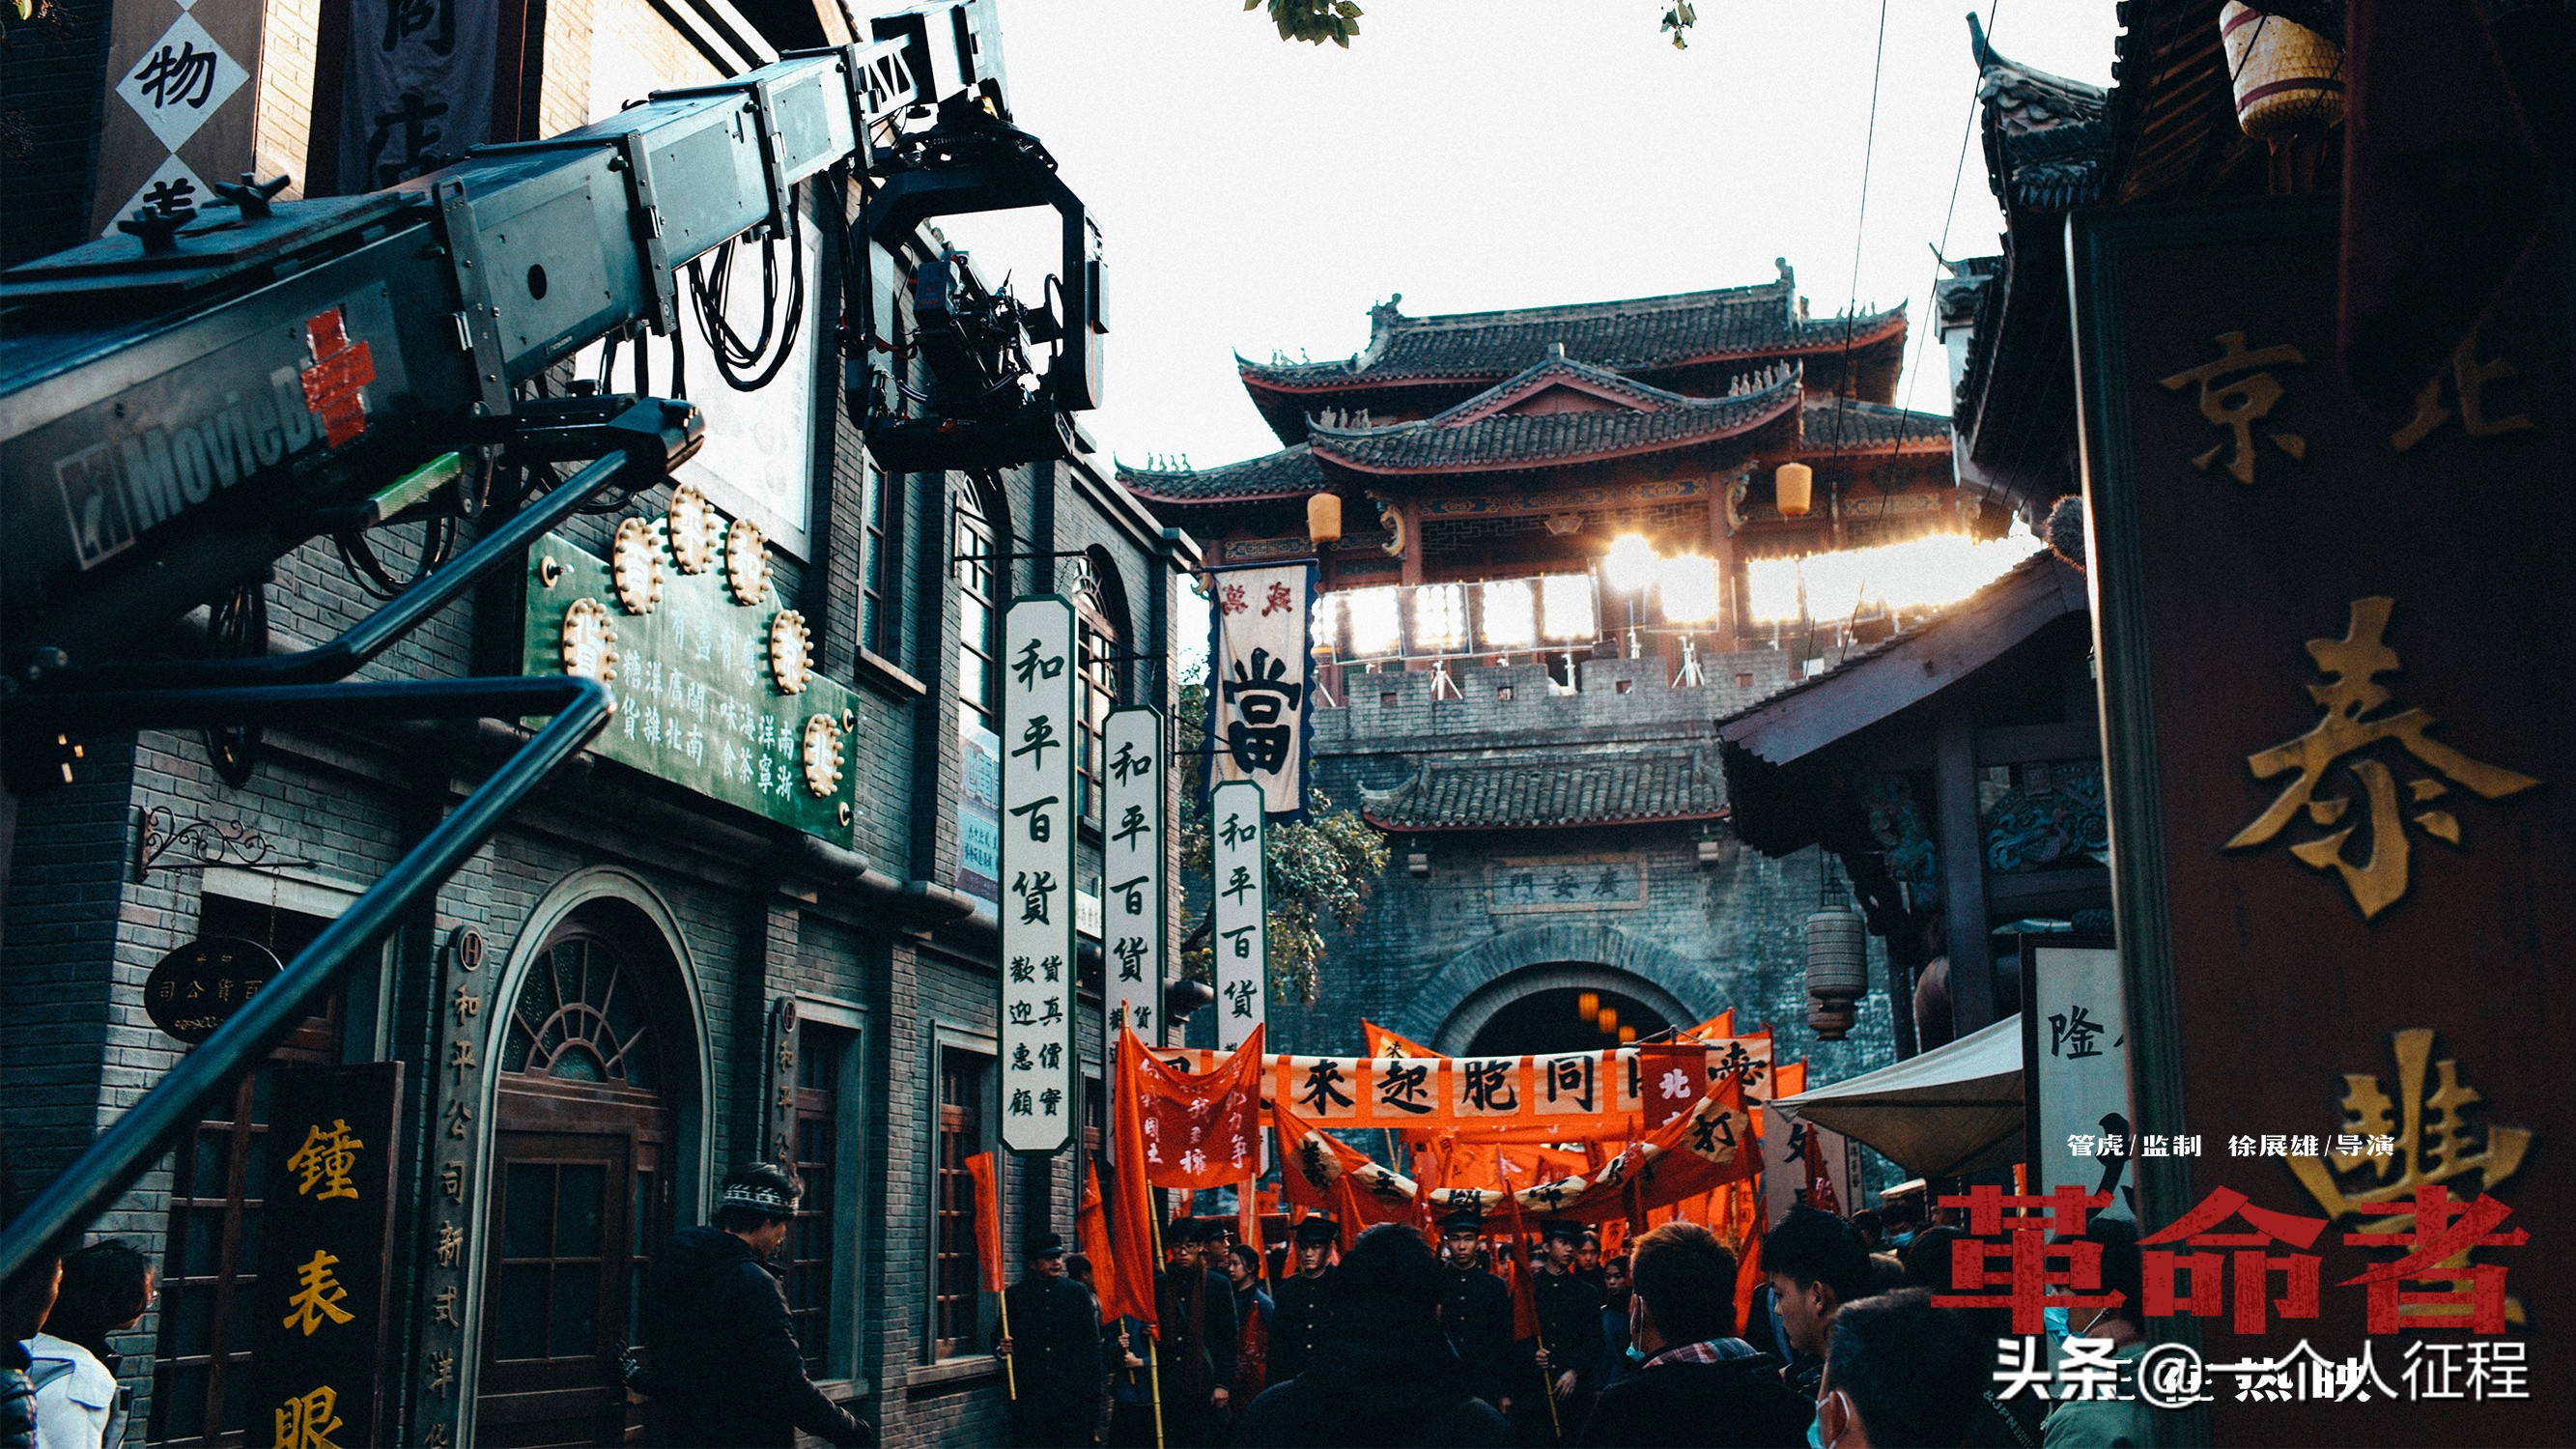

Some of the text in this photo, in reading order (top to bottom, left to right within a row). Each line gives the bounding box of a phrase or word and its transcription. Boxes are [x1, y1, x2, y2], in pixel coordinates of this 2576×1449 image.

[2159, 327, 2534, 483] 北京
[1010, 638, 1064, 925] 和平百貨
[1222, 646, 1302, 776] 當
[1108, 739, 1153, 983] 和平百貨
[1220, 812, 1259, 1019] 和平百貨
[1008, 954, 1038, 1118] 歡迎惠顧
[1037, 954, 1064, 1118] 貨真價實
[274, 1118, 364, 1449] 鐘表眼
